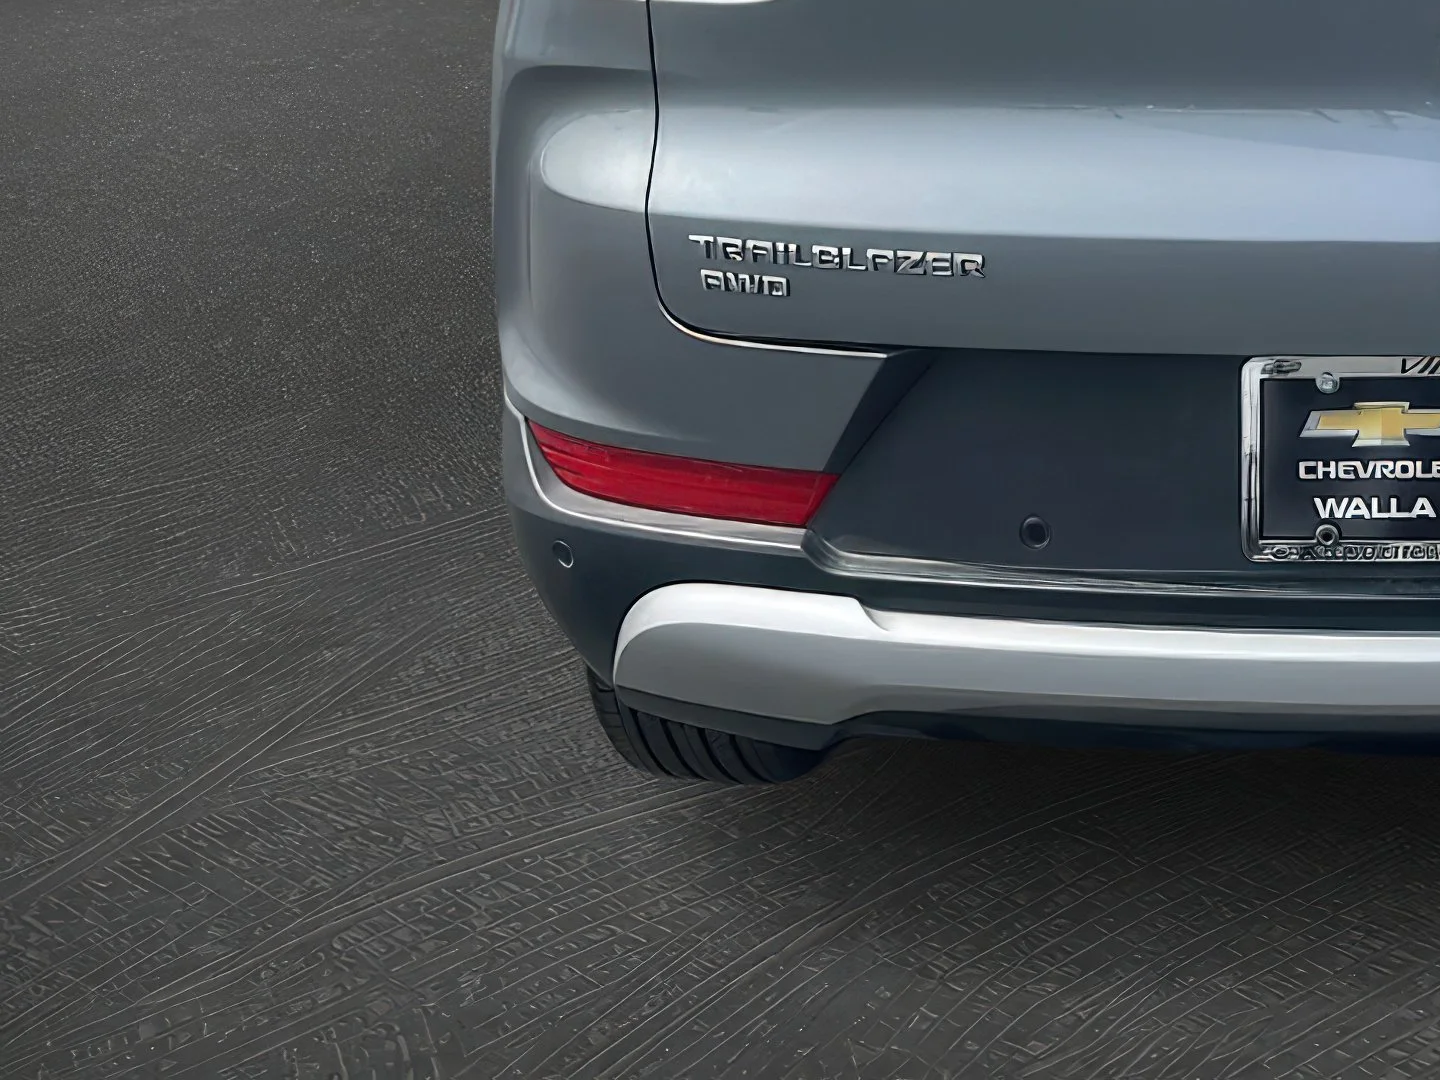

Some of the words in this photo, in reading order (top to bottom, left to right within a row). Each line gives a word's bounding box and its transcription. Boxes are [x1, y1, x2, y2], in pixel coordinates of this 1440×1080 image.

[688, 233, 987, 279] TRAILBLAZER
[700, 268, 791, 297] AWD
[1313, 496, 1437, 520] WALLA
